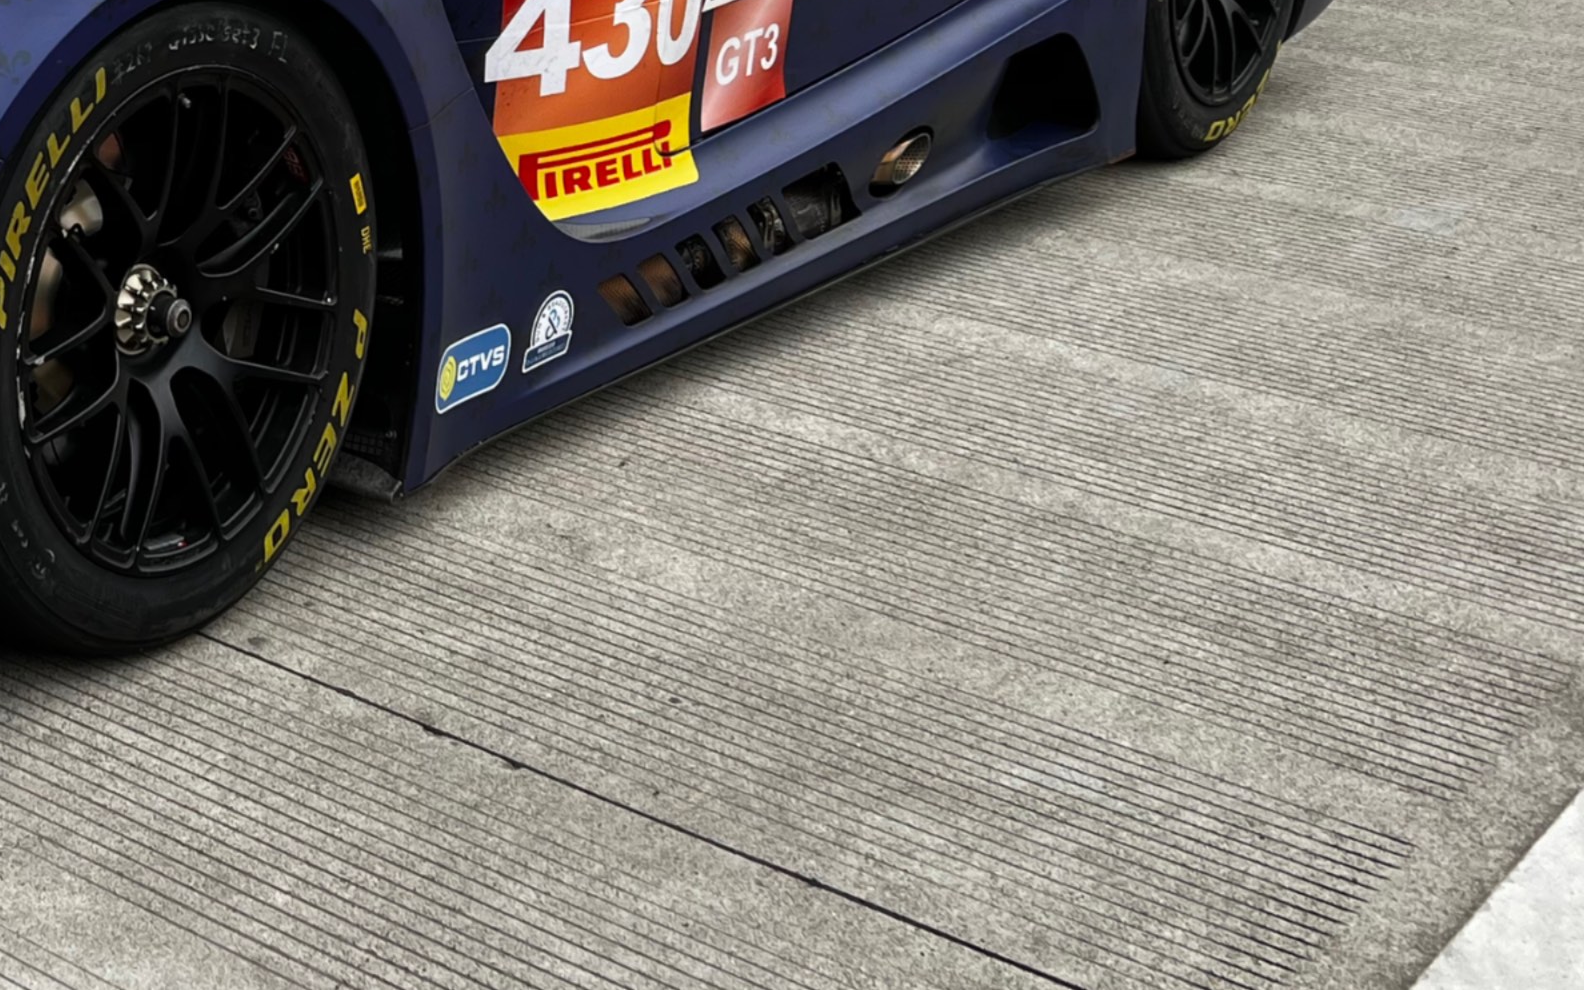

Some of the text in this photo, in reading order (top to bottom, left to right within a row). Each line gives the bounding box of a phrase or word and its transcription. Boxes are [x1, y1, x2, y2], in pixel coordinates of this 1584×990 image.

[715, 22, 780, 86] GT3
[517, 119, 672, 201] PIRELLI
[457, 345, 505, 382] CTVS
[264, 309, 368, 563] P ZERO
